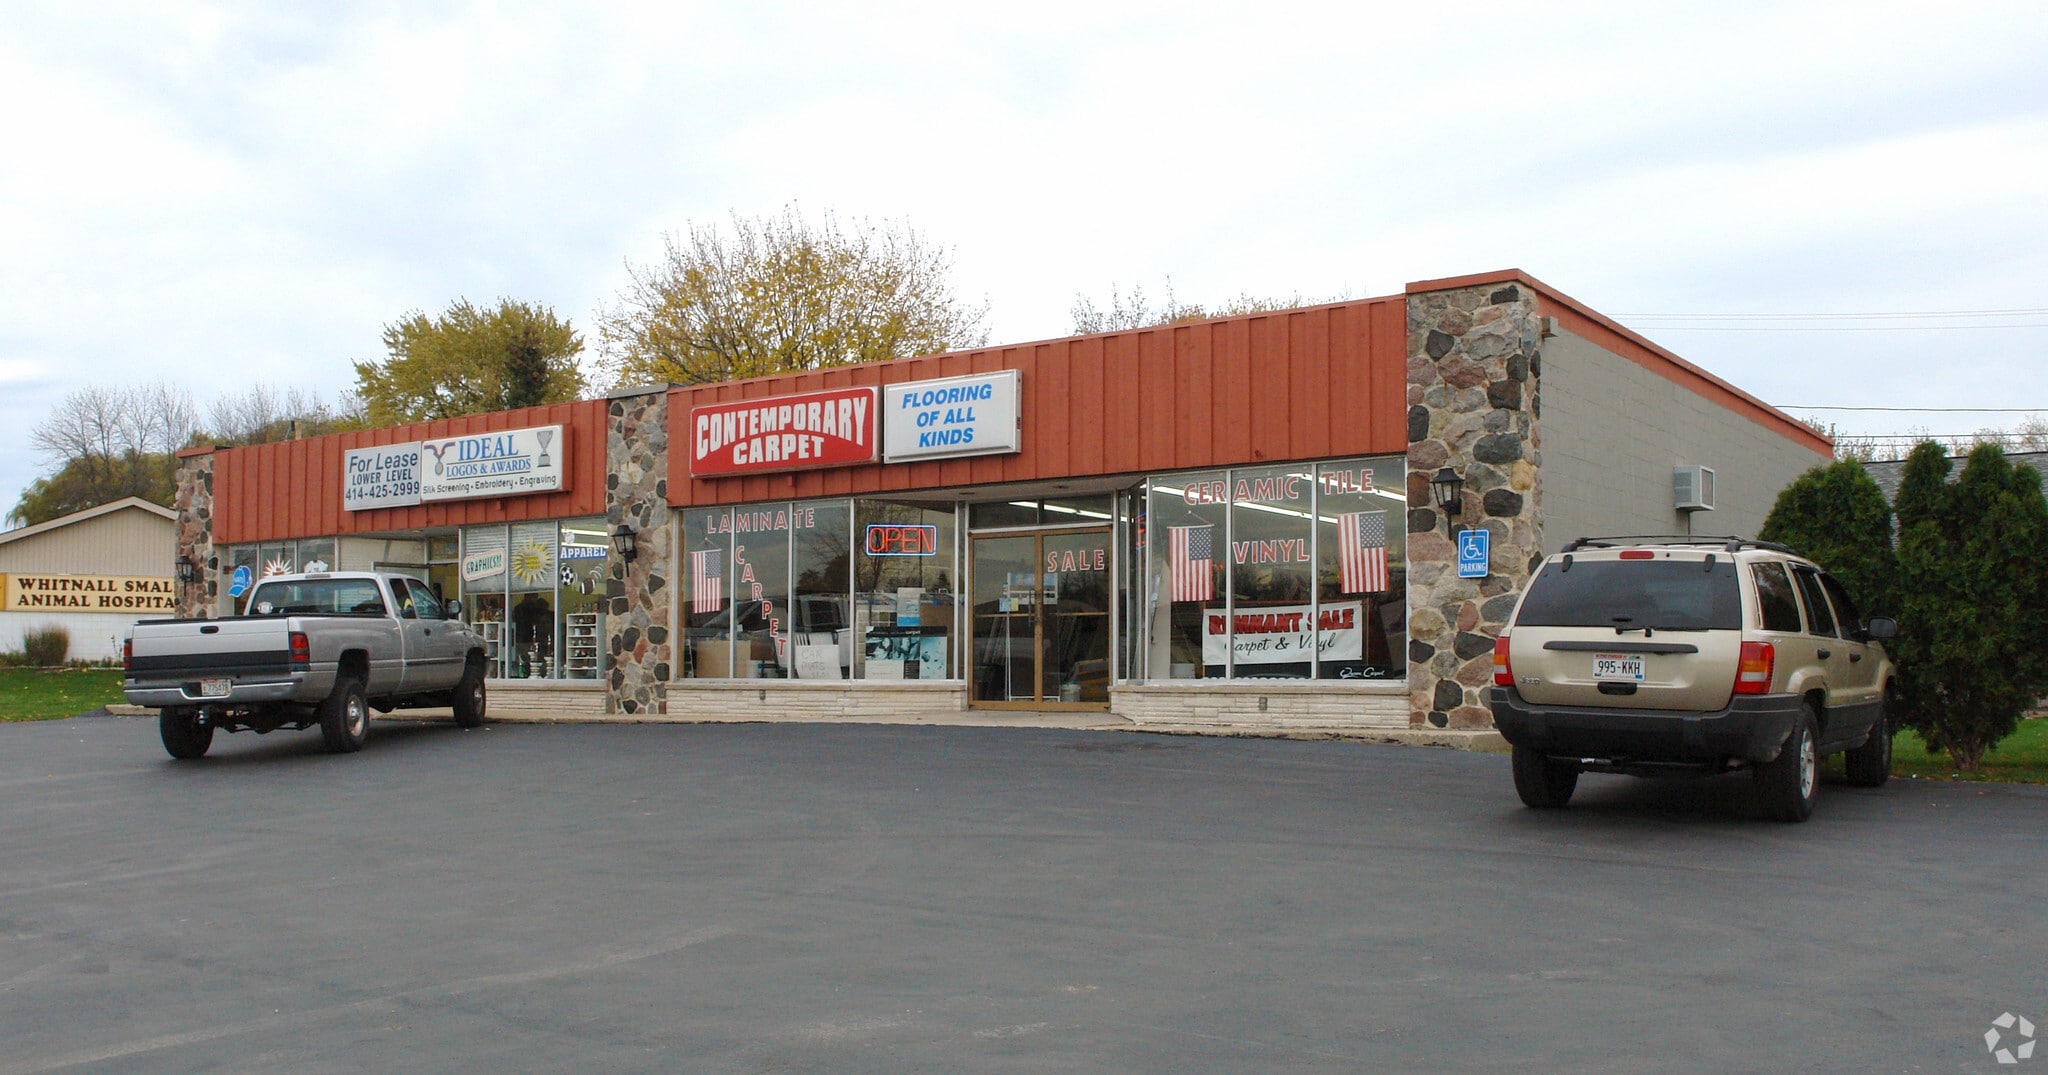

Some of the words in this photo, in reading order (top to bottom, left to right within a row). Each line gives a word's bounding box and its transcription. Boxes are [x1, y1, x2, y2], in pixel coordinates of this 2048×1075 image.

[902, 384, 992, 409] FLOORING
[916, 411, 939, 427] OF
[943, 407, 976, 424] ALL
[696, 396, 868, 461] CONTEMPORARY
[919, 428, 973, 447] KINDS
[458, 434, 519, 461] IDEAL
[733, 434, 825, 465] CARPET
[349, 456, 373, 474] For
[375, 452, 418, 470] Lease
[446, 467, 477, 478] LOGOS
[480, 465, 488, 474] &
[490, 458, 532, 473] AWARDS
[352, 472, 382, 486] LOWER
[386, 469, 413, 481] LEVEL
[422, 486, 435, 494] Silk
[436, 482, 470, 493] Screening
[475, 478, 514, 490] Embroidery
[519, 474, 557, 487] Engraving
[1183, 476, 1299, 505] CERAMIC
[1321, 468, 1374, 495] TILE
[345, 481, 420, 500] 414-425-2999
[707, 508, 815, 534] LAMINATE
[868, 527, 934, 553] OPEN
[560, 547, 607, 559] APPAREL
[1047, 549, 1105, 573] SALE
[1232, 538, 1310, 565] VINYL
[1460, 563, 1486, 572] PARKING
[18, 578, 117, 592] WHITNALL
[18, 594, 90, 607] ANIMAL
[98, 595, 174, 608] HOSPITA
[735, 545, 787, 656] CARPET
[1208, 612, 1303, 635] RMNANT
[1274, 637, 1290, 650] &
[1299, 632, 1336, 652] Viyl
[1598, 660, 1641, 675] 995-KKH
